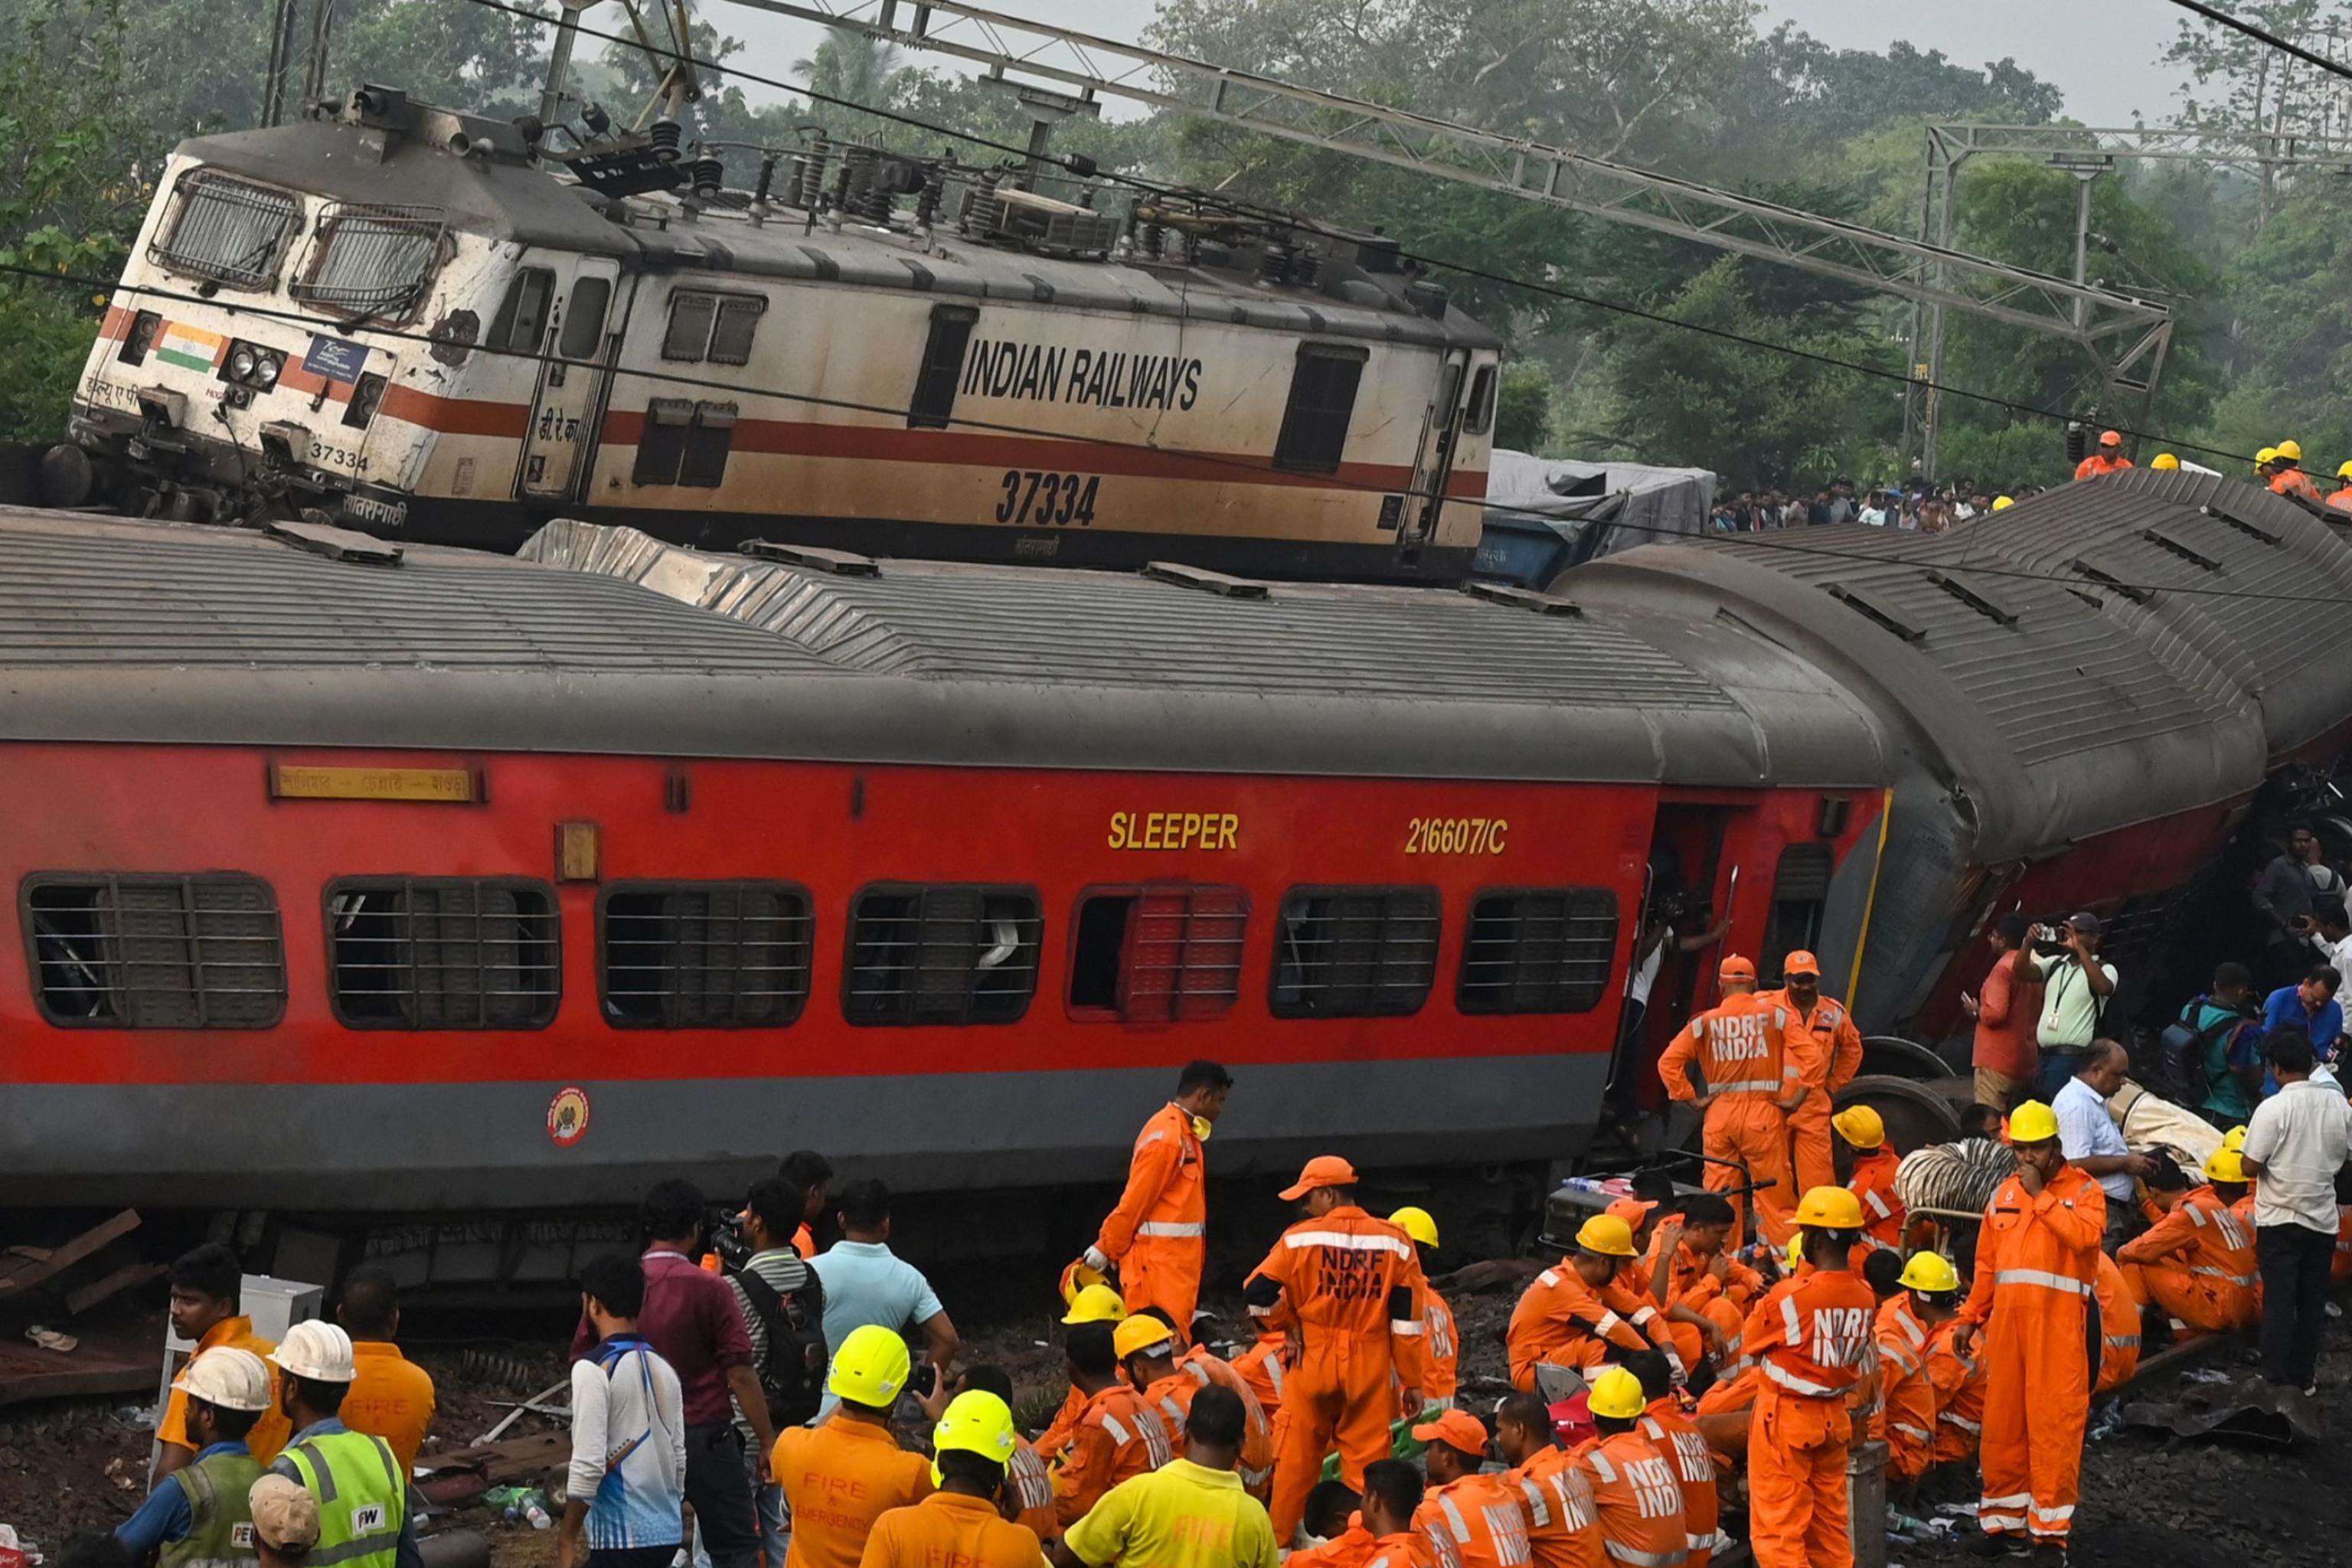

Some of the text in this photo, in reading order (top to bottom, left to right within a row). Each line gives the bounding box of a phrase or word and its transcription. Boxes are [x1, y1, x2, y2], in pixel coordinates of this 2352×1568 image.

[962, 339, 1202, 411] INDIAN RAILWAYS
[310, 442, 368, 472] 37334
[995, 470, 1101, 526] 37334
[1107, 811, 1239, 851] SLEEPER
[1404, 817, 1508, 855] 216607/C
[1710, 1012, 1769, 1039] NDRF
[1711, 1034, 1769, 1062] INDIA
[1321, 1246, 1385, 1271] NDRF
[1317, 1269, 1382, 1300] INDIA
[349, 1397, 410, 1415] FIRE
[803, 1472, 867, 1501] FIRE
[1635, 1484, 1684, 1520] INDI
